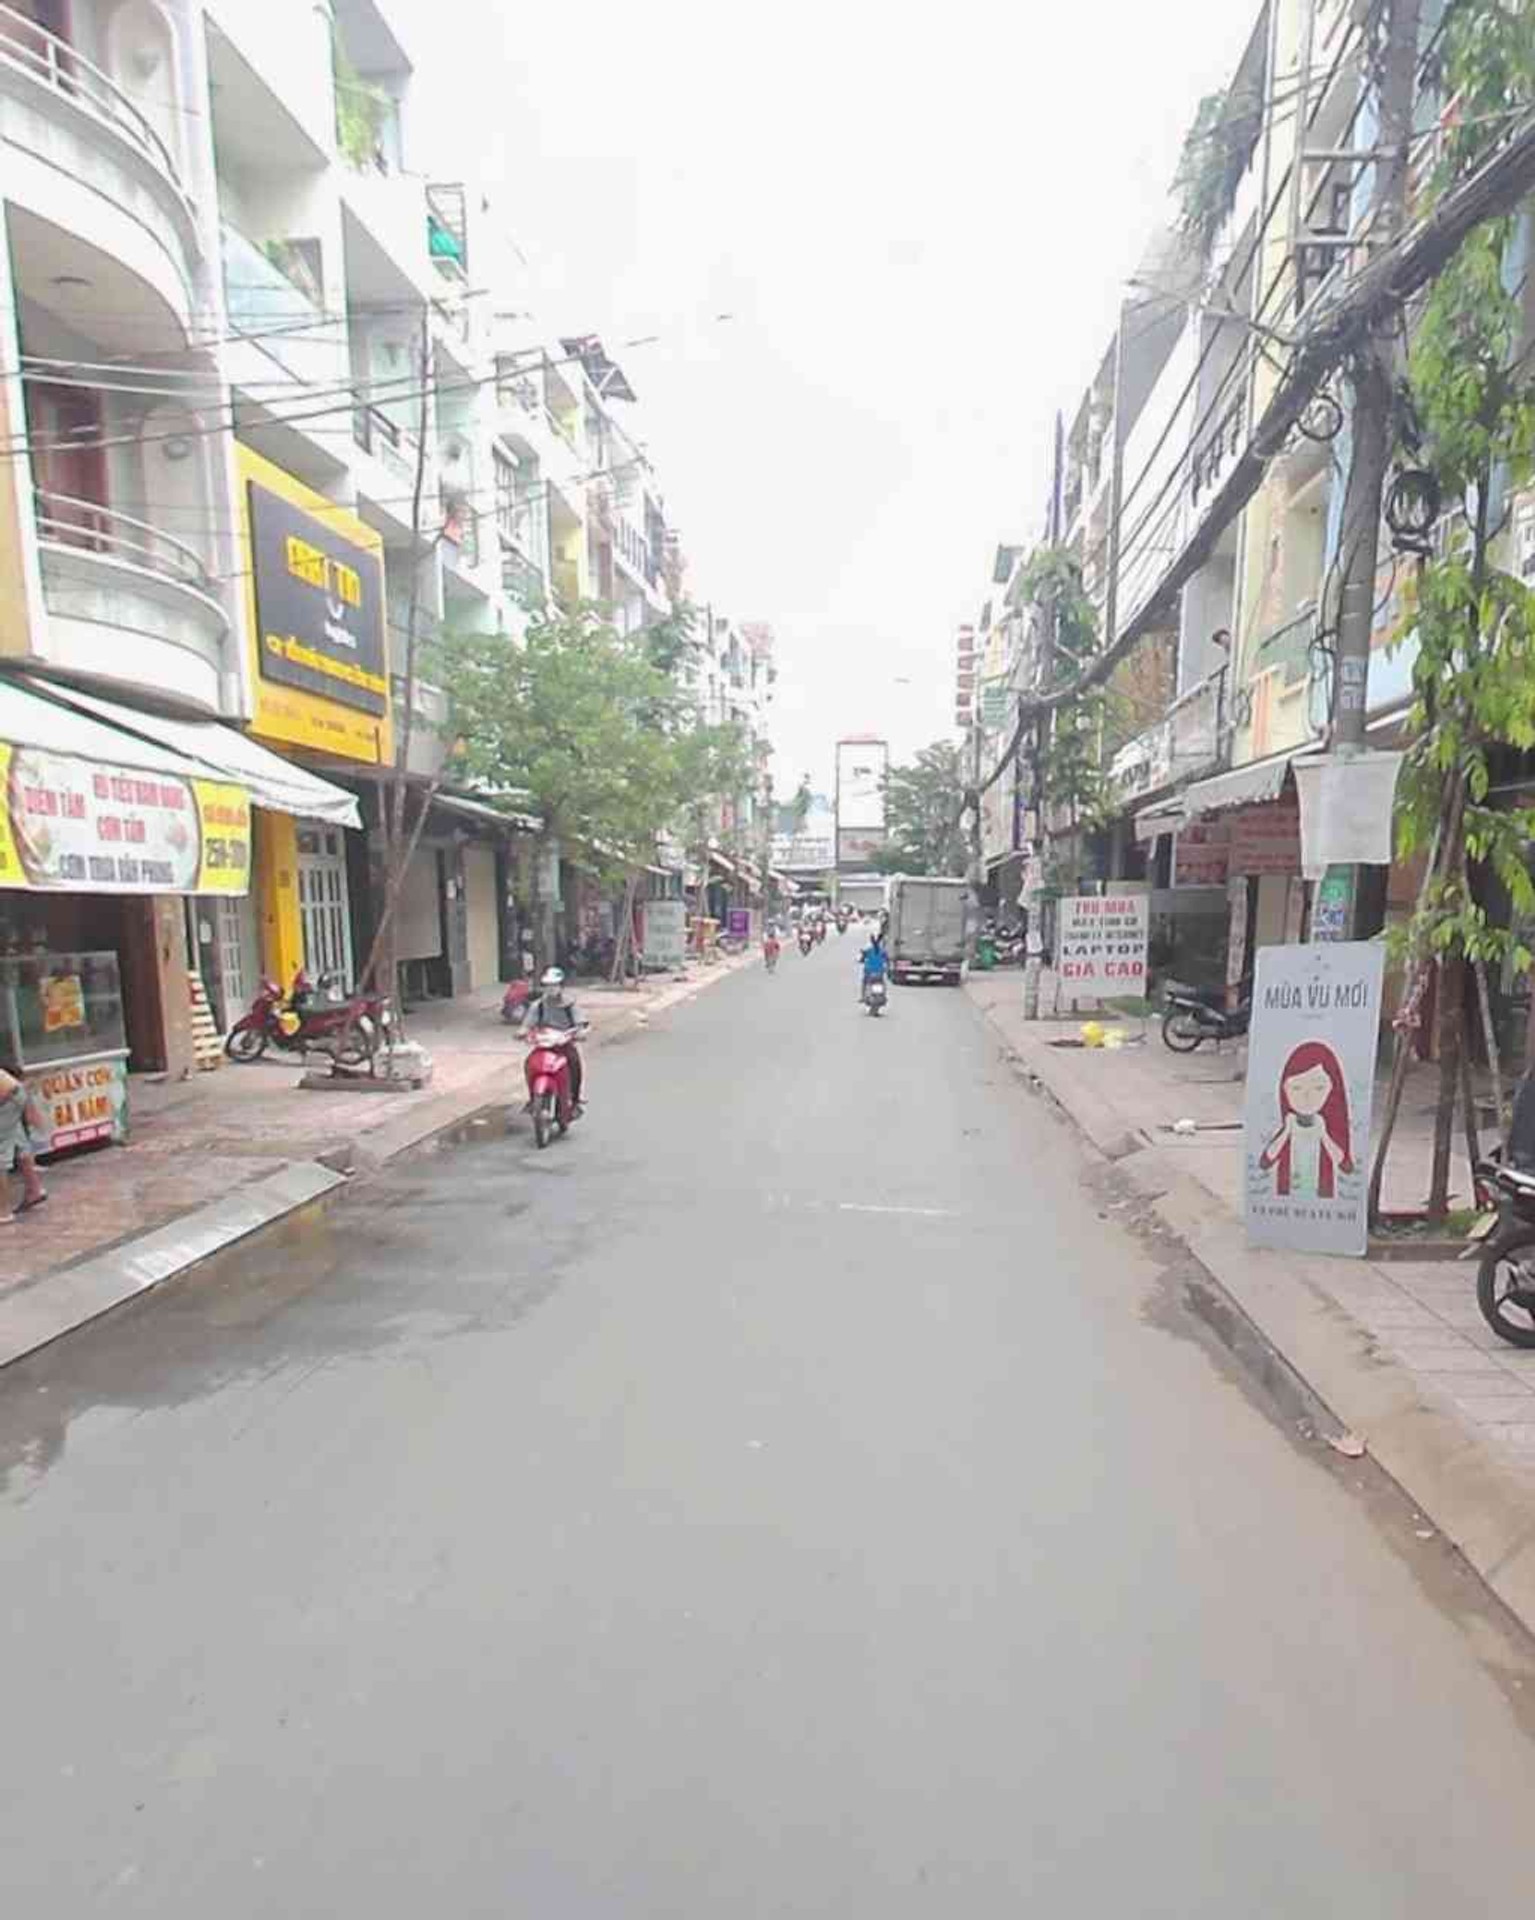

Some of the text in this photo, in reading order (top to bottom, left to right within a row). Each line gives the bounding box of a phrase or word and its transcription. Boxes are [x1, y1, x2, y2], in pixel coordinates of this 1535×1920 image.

[1063, 942, 1145, 956] LAPTOP
[1104, 961, 1143, 977] CAO
[1334, 979, 1368, 1009] MỚI
